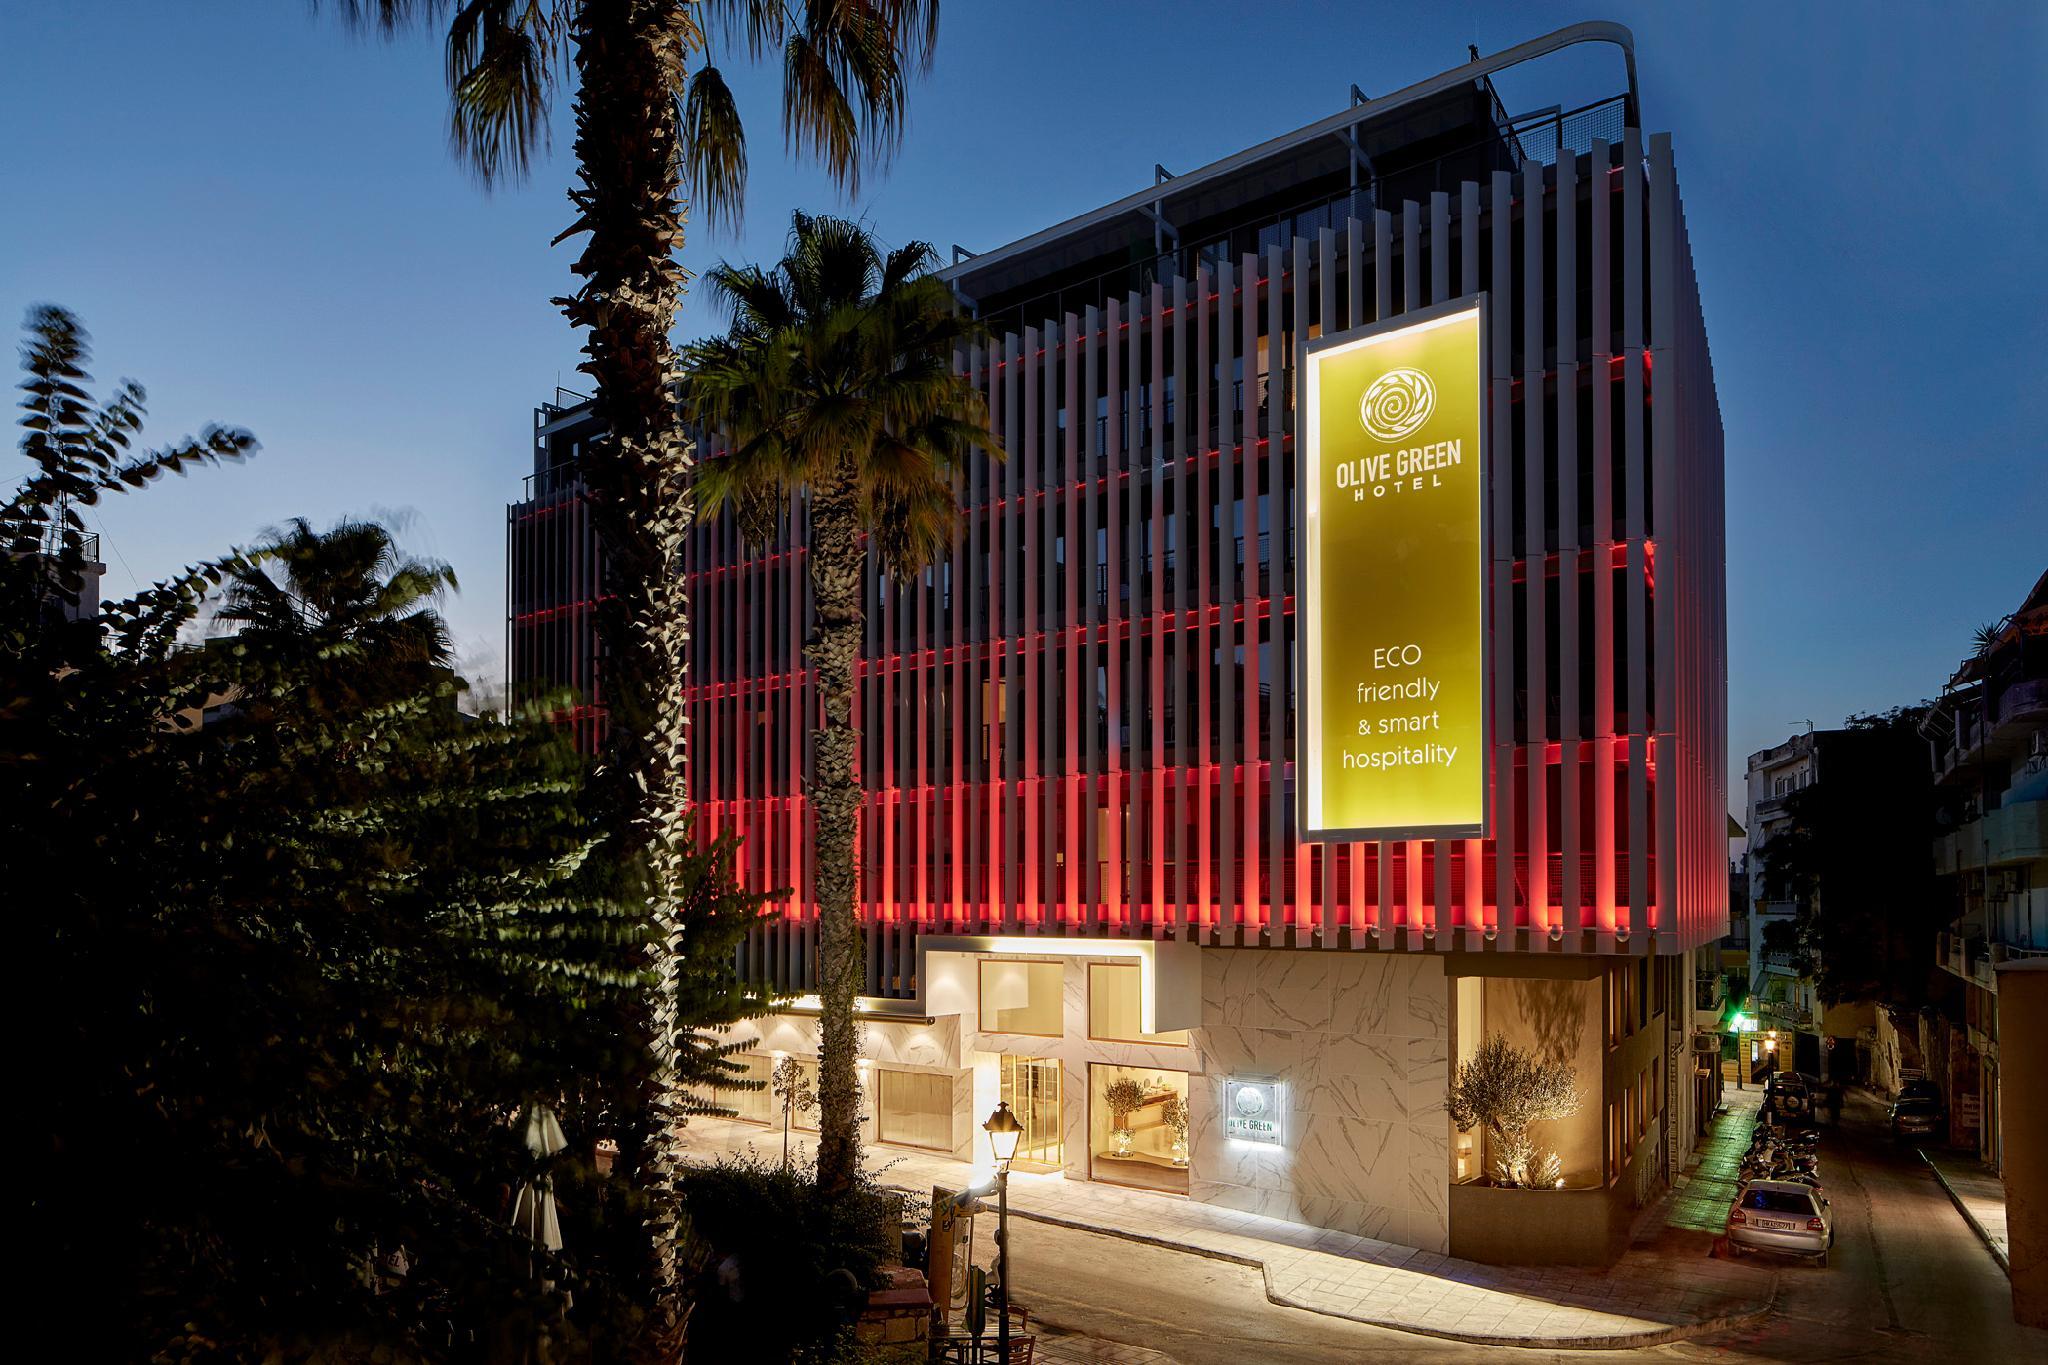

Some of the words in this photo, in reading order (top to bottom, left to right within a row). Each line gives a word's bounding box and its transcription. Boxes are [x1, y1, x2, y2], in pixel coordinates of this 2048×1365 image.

[1336, 453, 1391, 489] OLIVE
[1396, 438, 1461, 476] GREEN
[1354, 474, 1442, 502] HOTEL
[1374, 644, 1422, 669] ECO
[1357, 677, 1441, 703] friendly
[1358, 719, 1371, 736] &
[1378, 711, 1440, 734] smart
[1343, 743, 1458, 771] hospitality
[1248, 1119, 1273, 1132] GREEN
